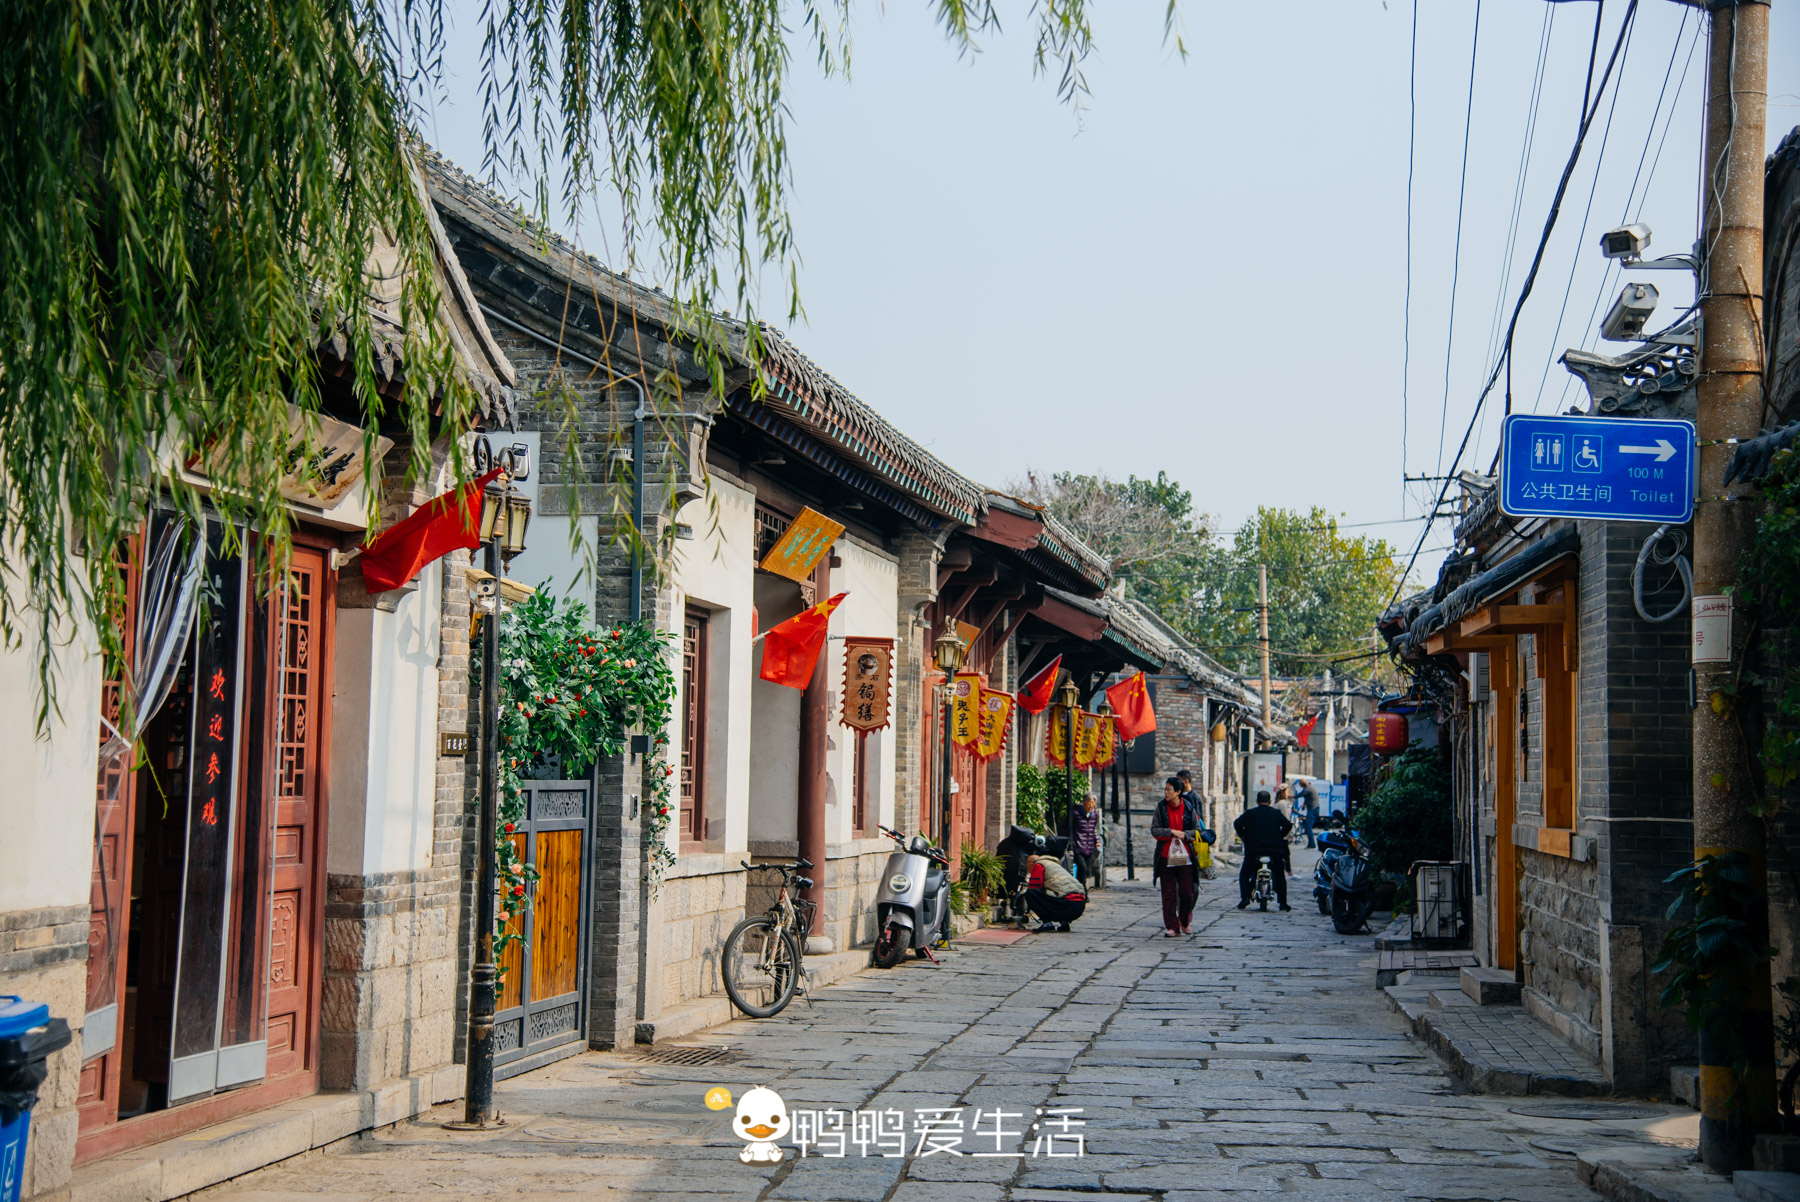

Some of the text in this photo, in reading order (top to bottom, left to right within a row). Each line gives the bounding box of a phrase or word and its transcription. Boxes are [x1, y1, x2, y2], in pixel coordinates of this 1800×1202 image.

[1627, 467, 1664, 479] 100 M
[1521, 481, 1612, 503] 公共卫生间
[1630, 489, 1675, 503] Toilet
[202, 667, 225, 826] 欢迎参观
